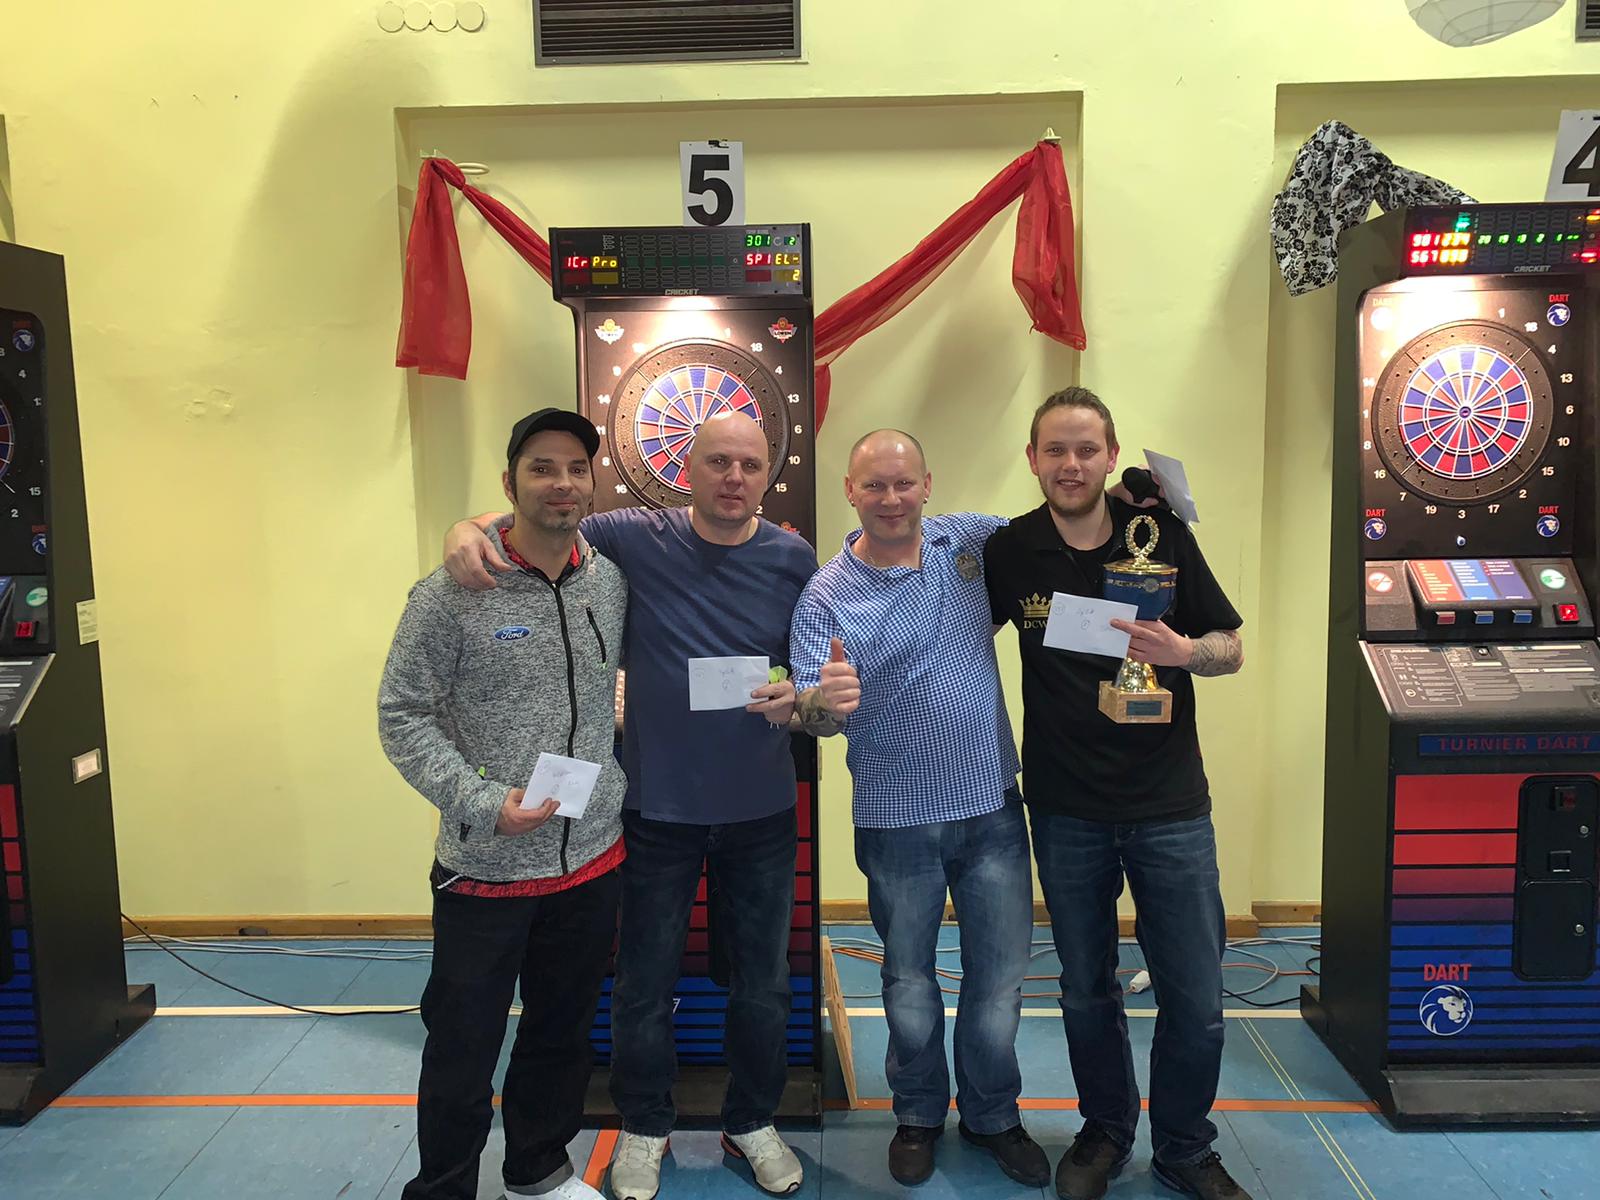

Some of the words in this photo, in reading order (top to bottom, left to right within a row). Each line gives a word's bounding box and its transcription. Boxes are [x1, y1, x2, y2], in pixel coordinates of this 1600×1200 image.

[1562, 123, 1600, 197] 4
[687, 154, 734, 226] 5
[746, 235, 771, 246] 301
[593, 256, 617, 268] Pro
[1513, 265, 1552, 273] CRICKET
[792, 269, 800, 281] 2
[664, 288, 700, 296] CRICKET
[1548, 294, 1570, 303] DART
[1497, 307, 1506, 319] 1
[750, 342, 763, 353] 18
[1547, 344, 1557, 355] 4
[18, 369, 27, 379] 4
[774, 365, 783, 375] 4
[1560, 373, 1573, 383] 13
[787, 393, 800, 404] 13
[1565, 405, 1574, 415] 6
[794, 424, 803, 434] 6
[1363, 440, 1372, 450] 8
[1557, 436, 1570, 447] 10
[602, 456, 611, 467] 8
[788, 455, 801, 465] 10
[1373, 469, 1386, 479] 16
[1541, 466, 1554, 476] 15
[28, 486, 41, 496] 15
[614, 483, 628, 494] 16
[774, 482, 787, 493] 15
[1399, 491, 1407, 501] 7
[1518, 489, 1527, 499] 2
[10, 508, 19, 518] 2
[754, 505, 763, 516] 2
[1365, 508, 1386, 517] DART
[1424, 504, 1437, 515] 19
[1457, 509, 1466, 519] 3
[1487, 504, 1500, 514] 17
[1538, 505, 1559, 514] DART
[501, 629, 523, 640] Ford
[1537, 735, 1592, 751] DART
[1423, 963, 1472, 981] DART
